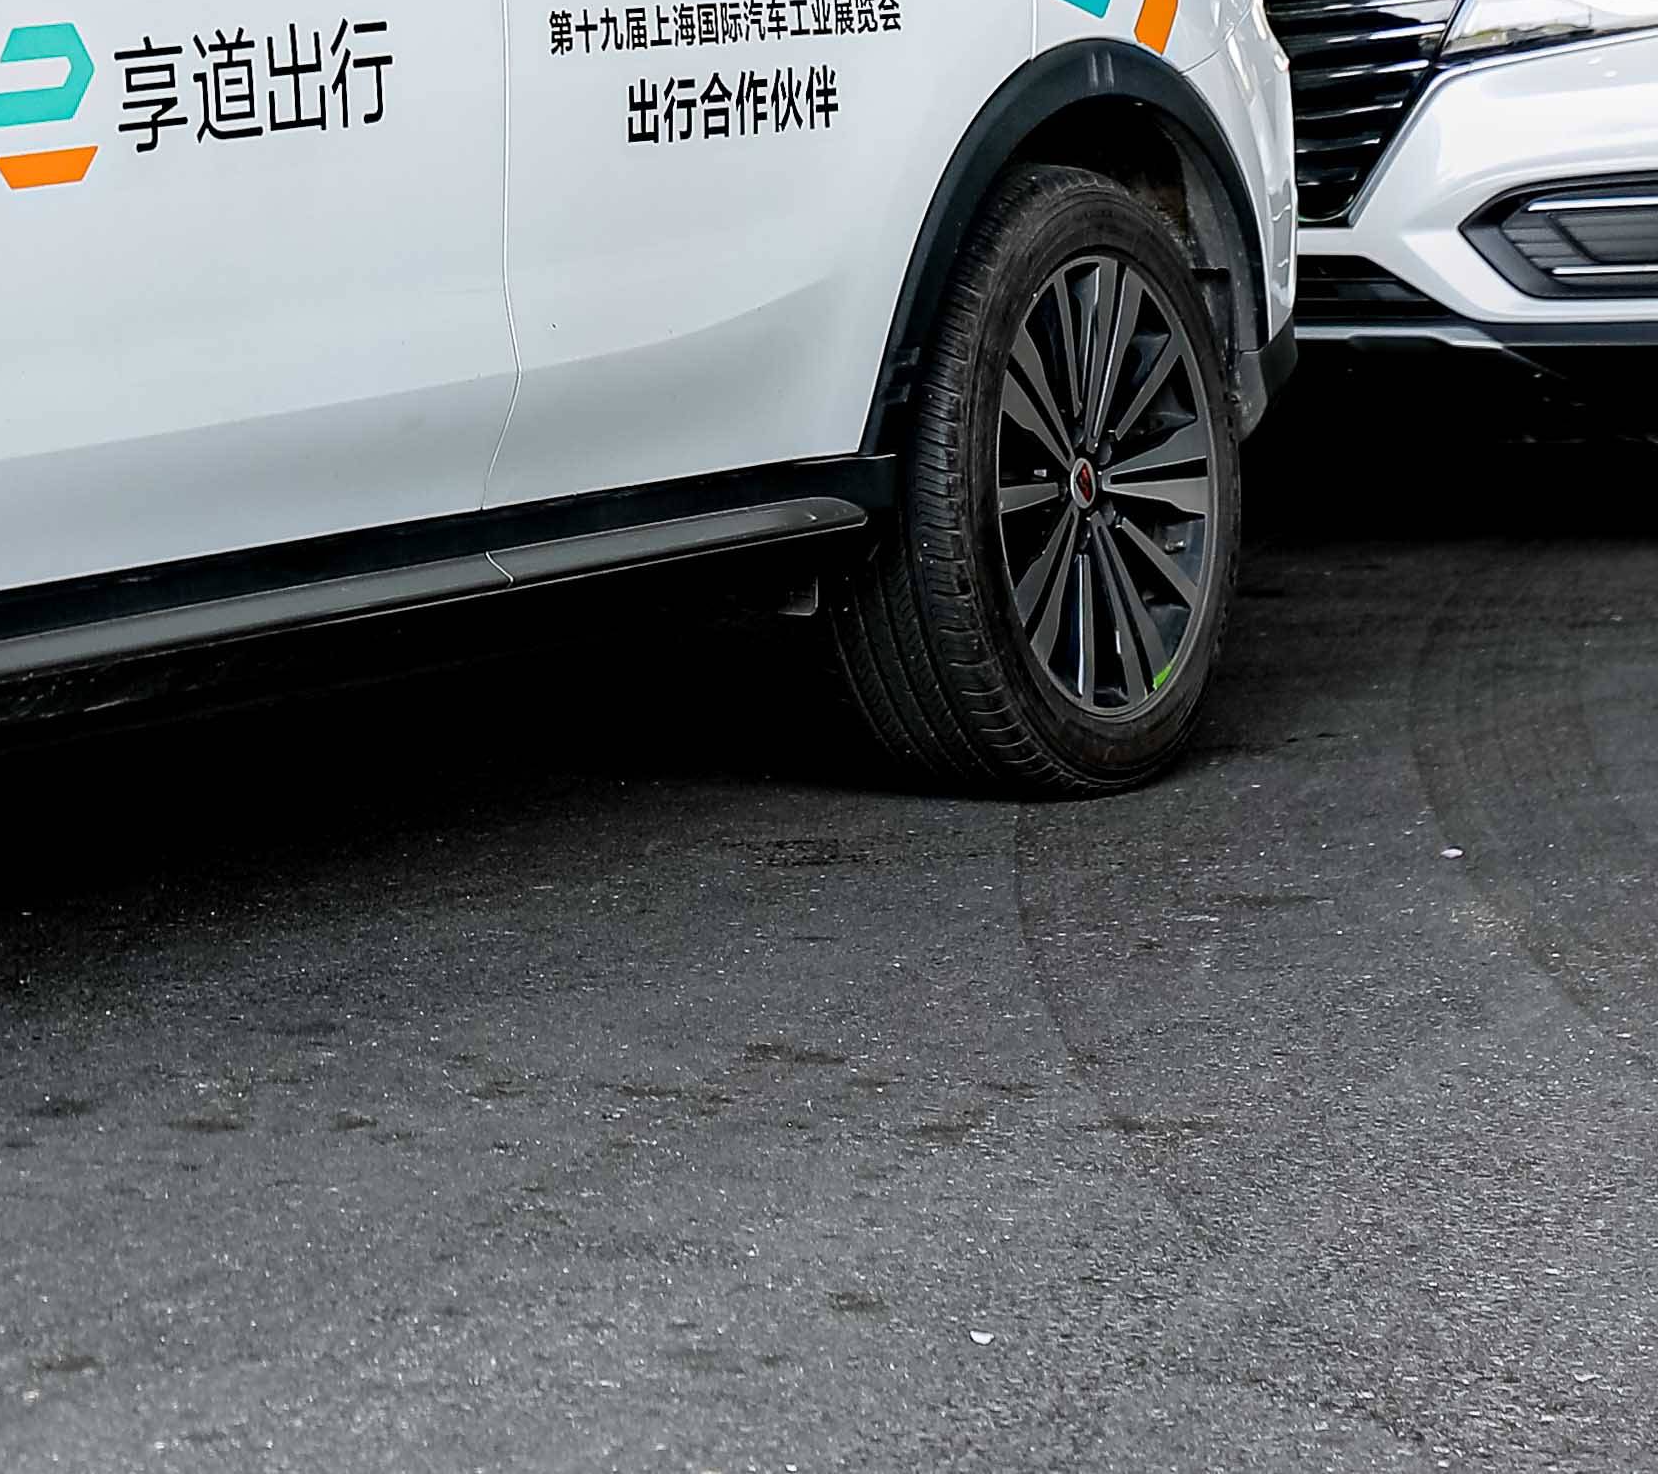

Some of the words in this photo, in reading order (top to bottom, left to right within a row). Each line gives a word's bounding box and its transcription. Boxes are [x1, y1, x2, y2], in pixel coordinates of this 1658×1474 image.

[113, 18, 393, 153] 享道出行
[627, 64, 839, 144] 出行合作伙伴
